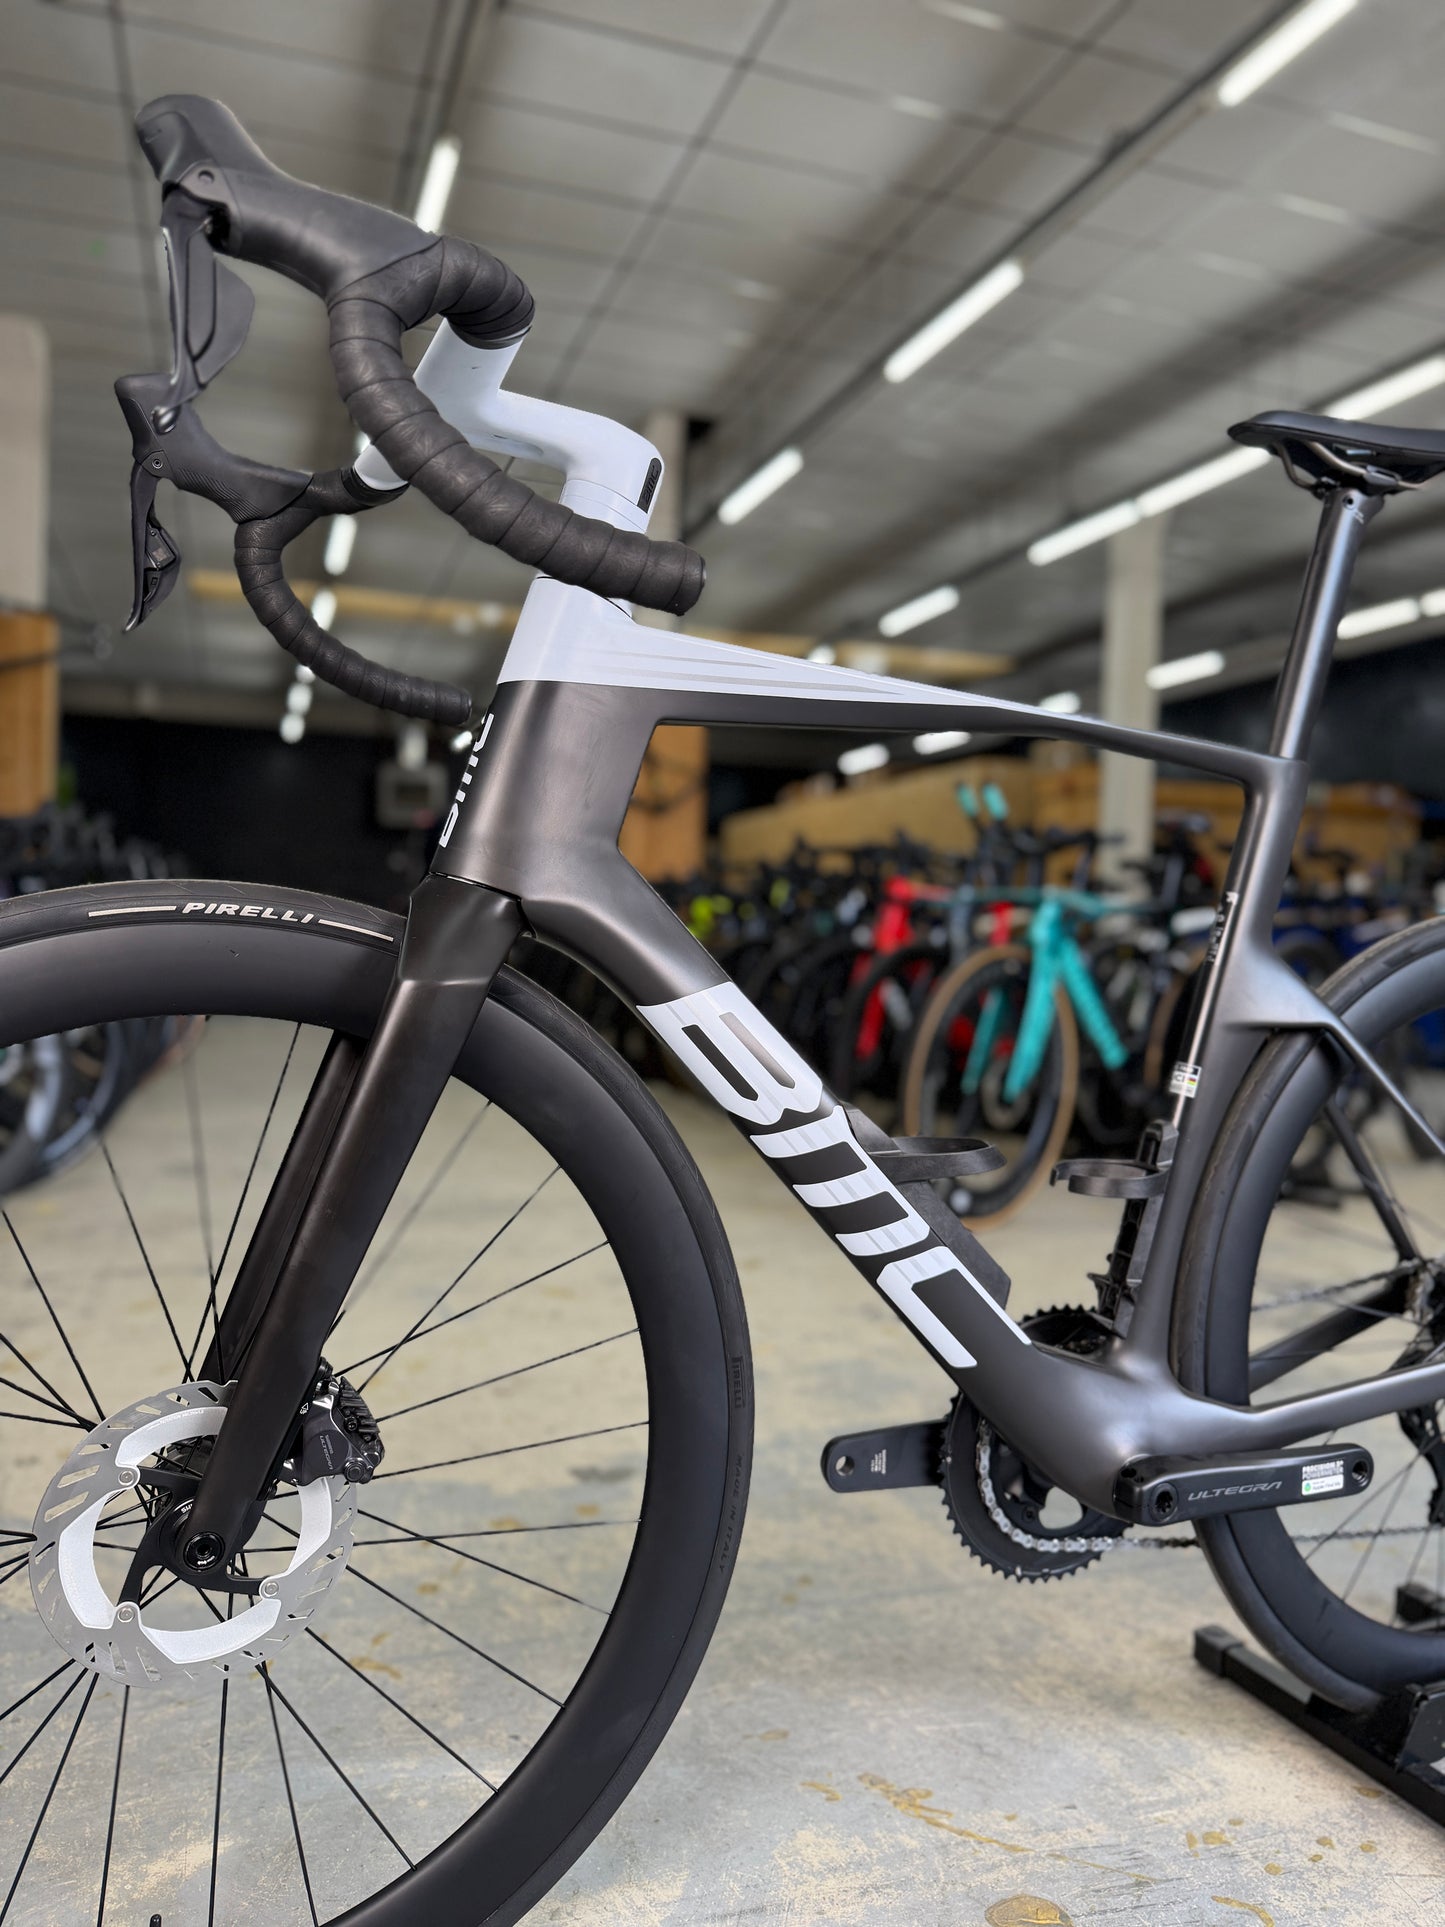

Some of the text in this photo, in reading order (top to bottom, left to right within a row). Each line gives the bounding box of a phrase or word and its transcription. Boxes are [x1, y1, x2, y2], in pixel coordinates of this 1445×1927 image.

[182, 902, 315, 924] PIRELLI
[636, 981, 1032, 1368] BMC
[731, 1355, 746, 1409] PIRELLI
[719, 1454, 743, 1574] MADE IN ITALY
[1187, 1480, 1283, 1501] ULTEGRA
